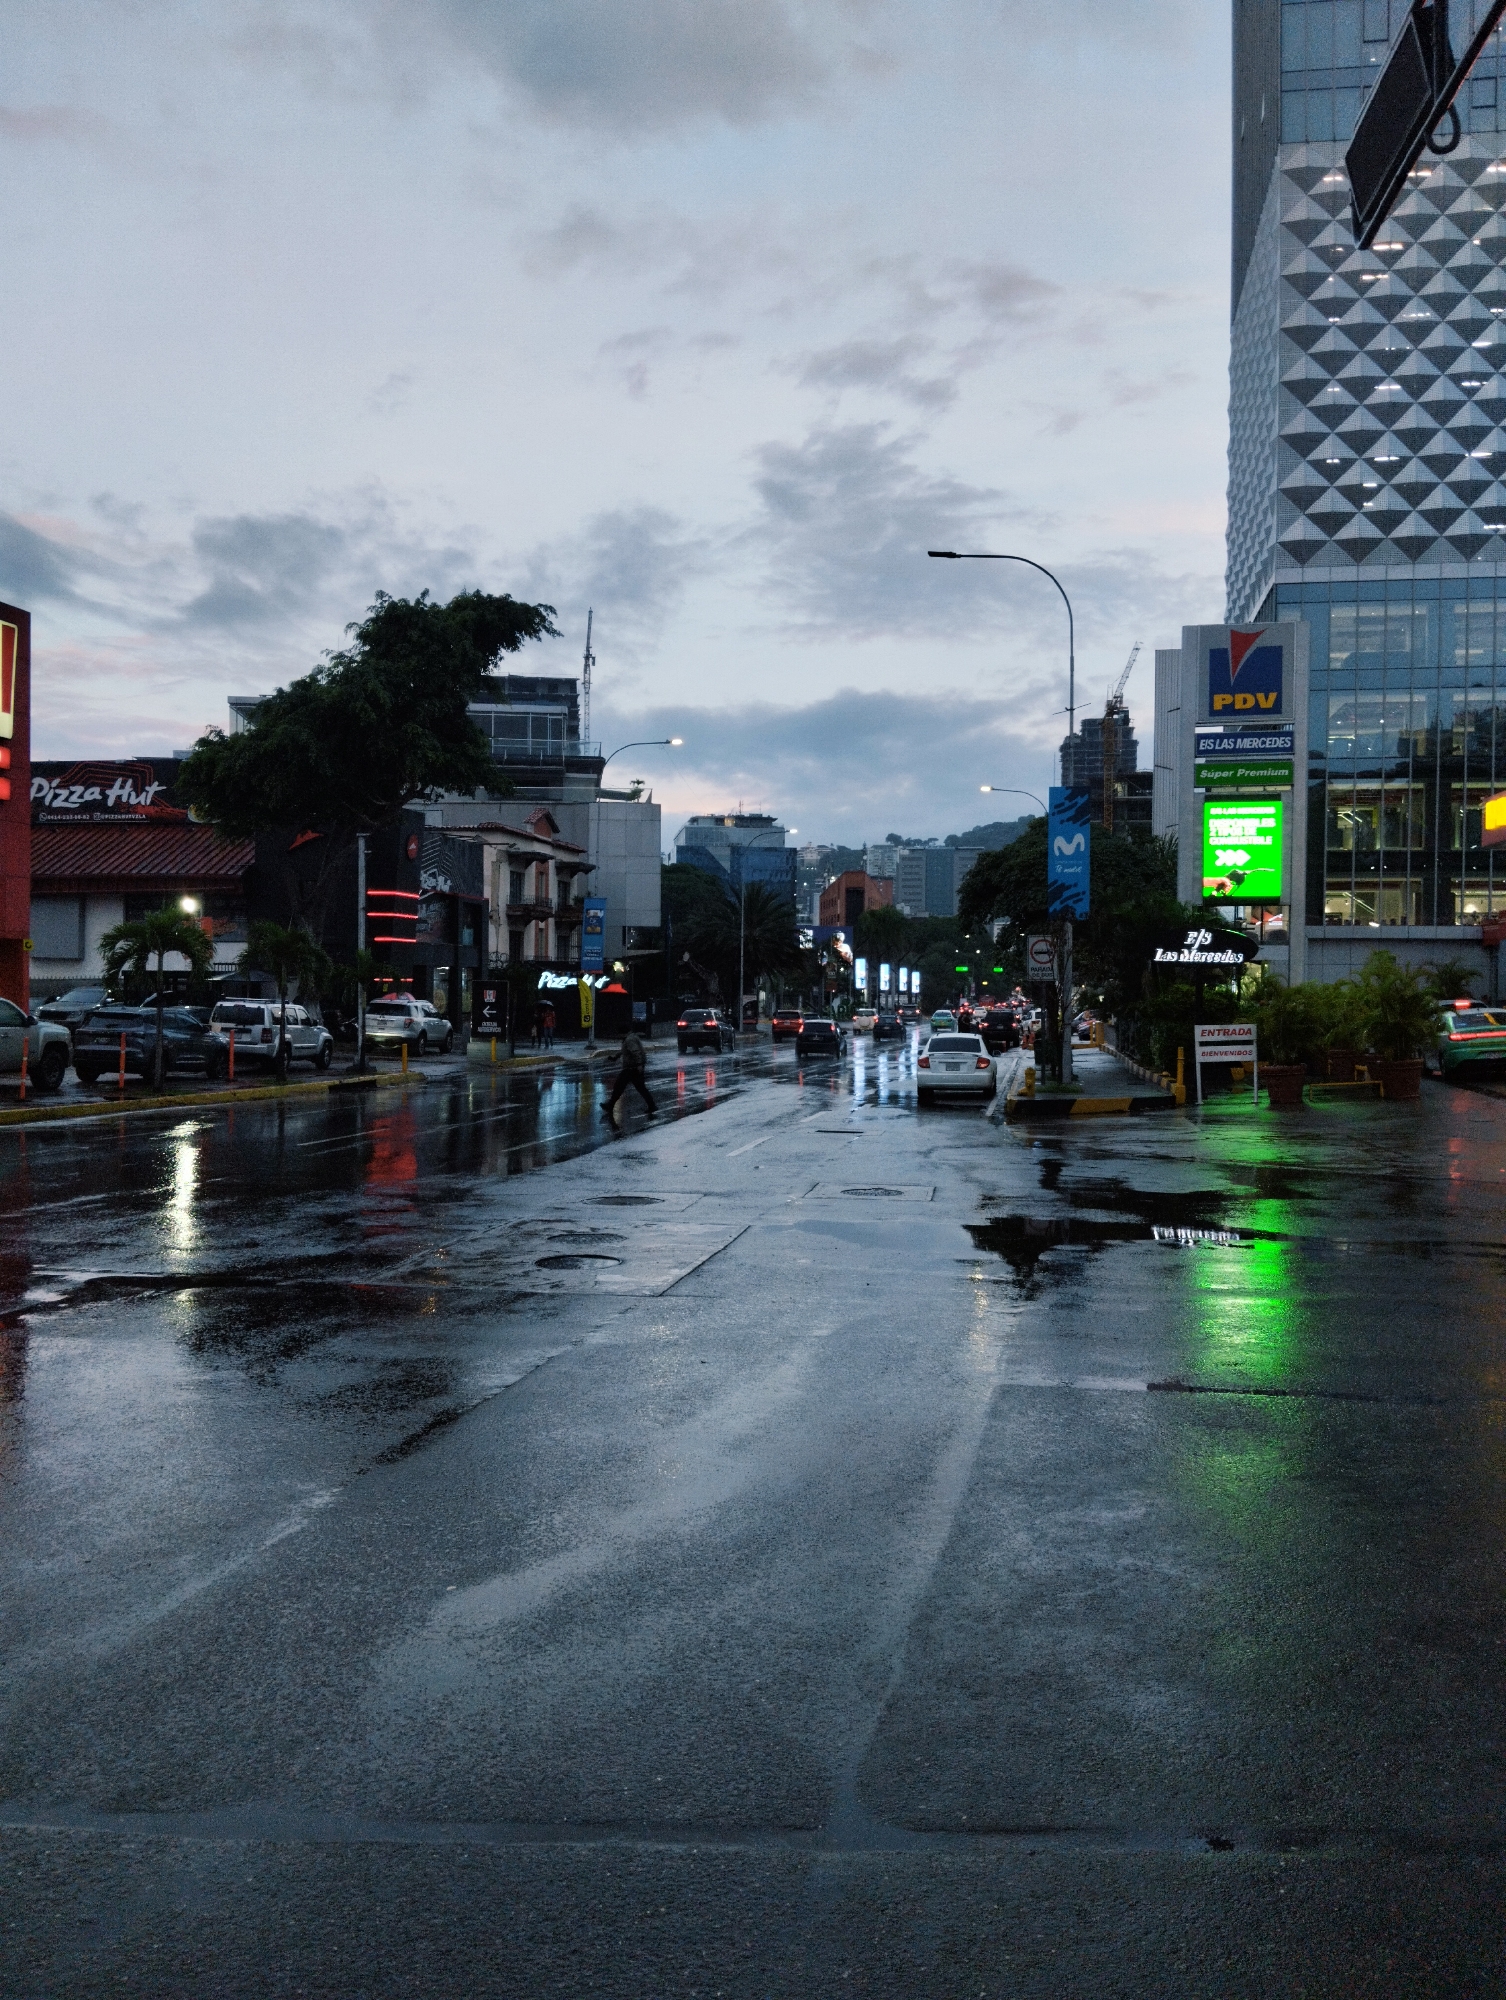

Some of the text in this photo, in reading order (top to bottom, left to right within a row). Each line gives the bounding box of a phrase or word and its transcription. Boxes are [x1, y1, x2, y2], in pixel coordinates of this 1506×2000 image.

[1212, 691, 1278, 711] PDV
[1215, 738, 1235, 749] LAS
[1236, 736, 1292, 749] MERCEDES
[1236, 768, 1289, 777] Premium
[30, 776, 167, 808] Pizza Hut
[1154, 948, 1244, 963] Las Mercedes
[537, 971, 578, 989] Pizza
[1200, 1028, 1252, 1037] ENTRADA
